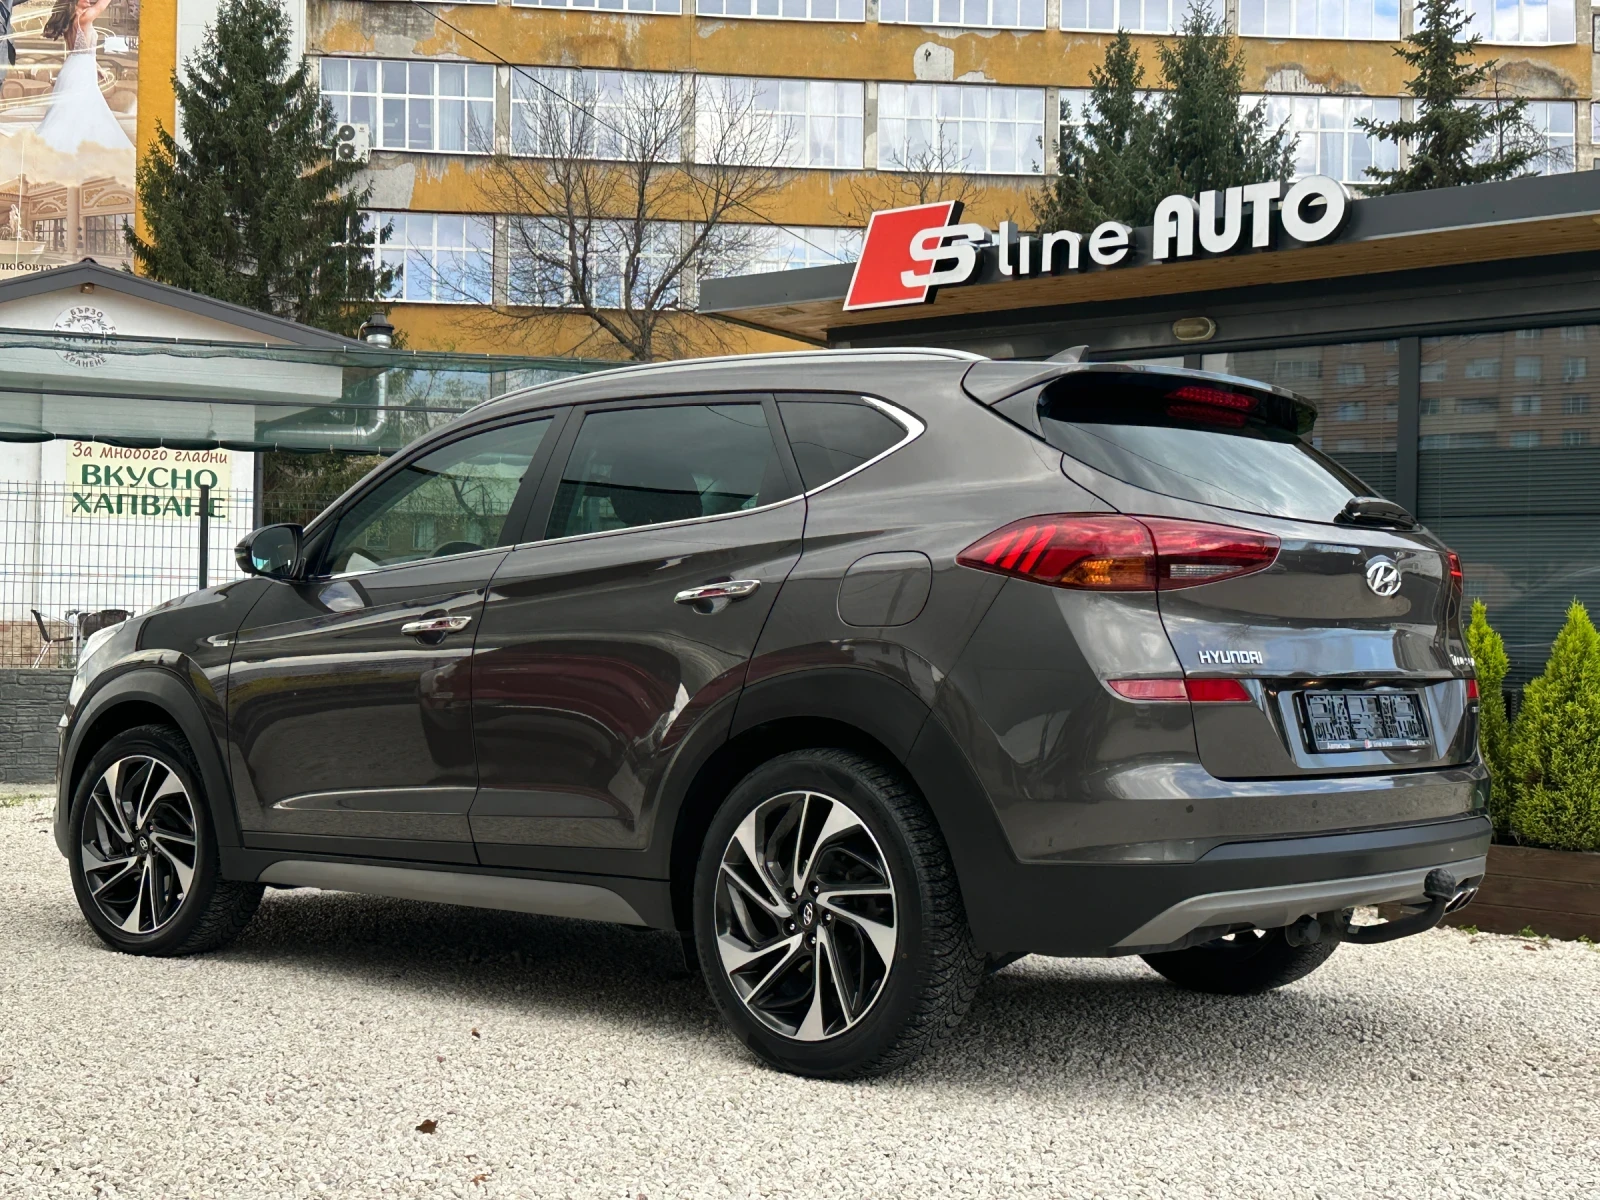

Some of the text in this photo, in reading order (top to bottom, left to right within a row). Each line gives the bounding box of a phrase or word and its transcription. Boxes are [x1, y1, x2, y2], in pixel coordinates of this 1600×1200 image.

[998, 220, 1129, 276] line
[1152, 174, 1346, 260] AUTO
[70, 307, 104, 318] БЪРЗО
[72, 441, 92, 457] За
[174, 450, 227, 464] гладни
[81, 464, 218, 489] ВКУСНО
[1198, 650, 1263, 664] HYUNDAI
